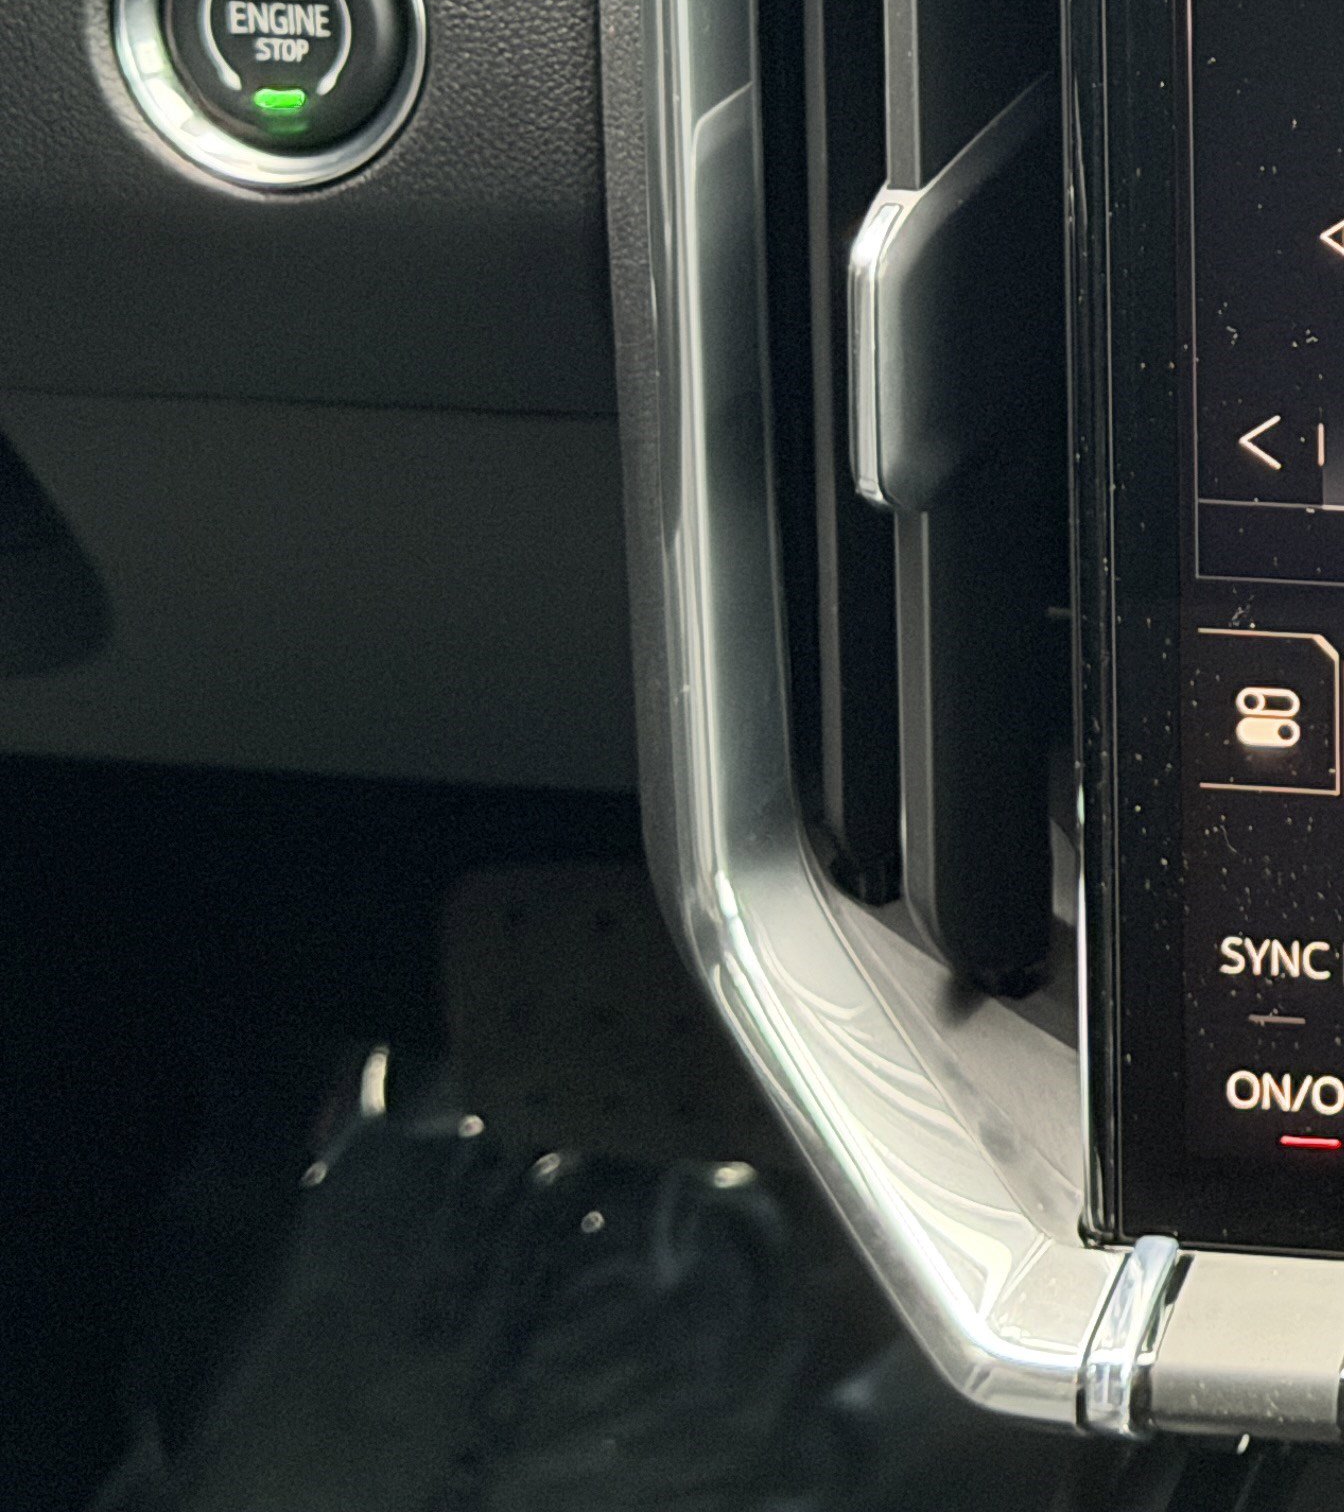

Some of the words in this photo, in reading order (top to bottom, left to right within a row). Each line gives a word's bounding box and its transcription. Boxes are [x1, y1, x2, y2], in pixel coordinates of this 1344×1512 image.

[228, 1, 332, 38] ENGINE
[254, 37, 310, 63] STOP
[1218, 935, 1332, 981] SYNC
